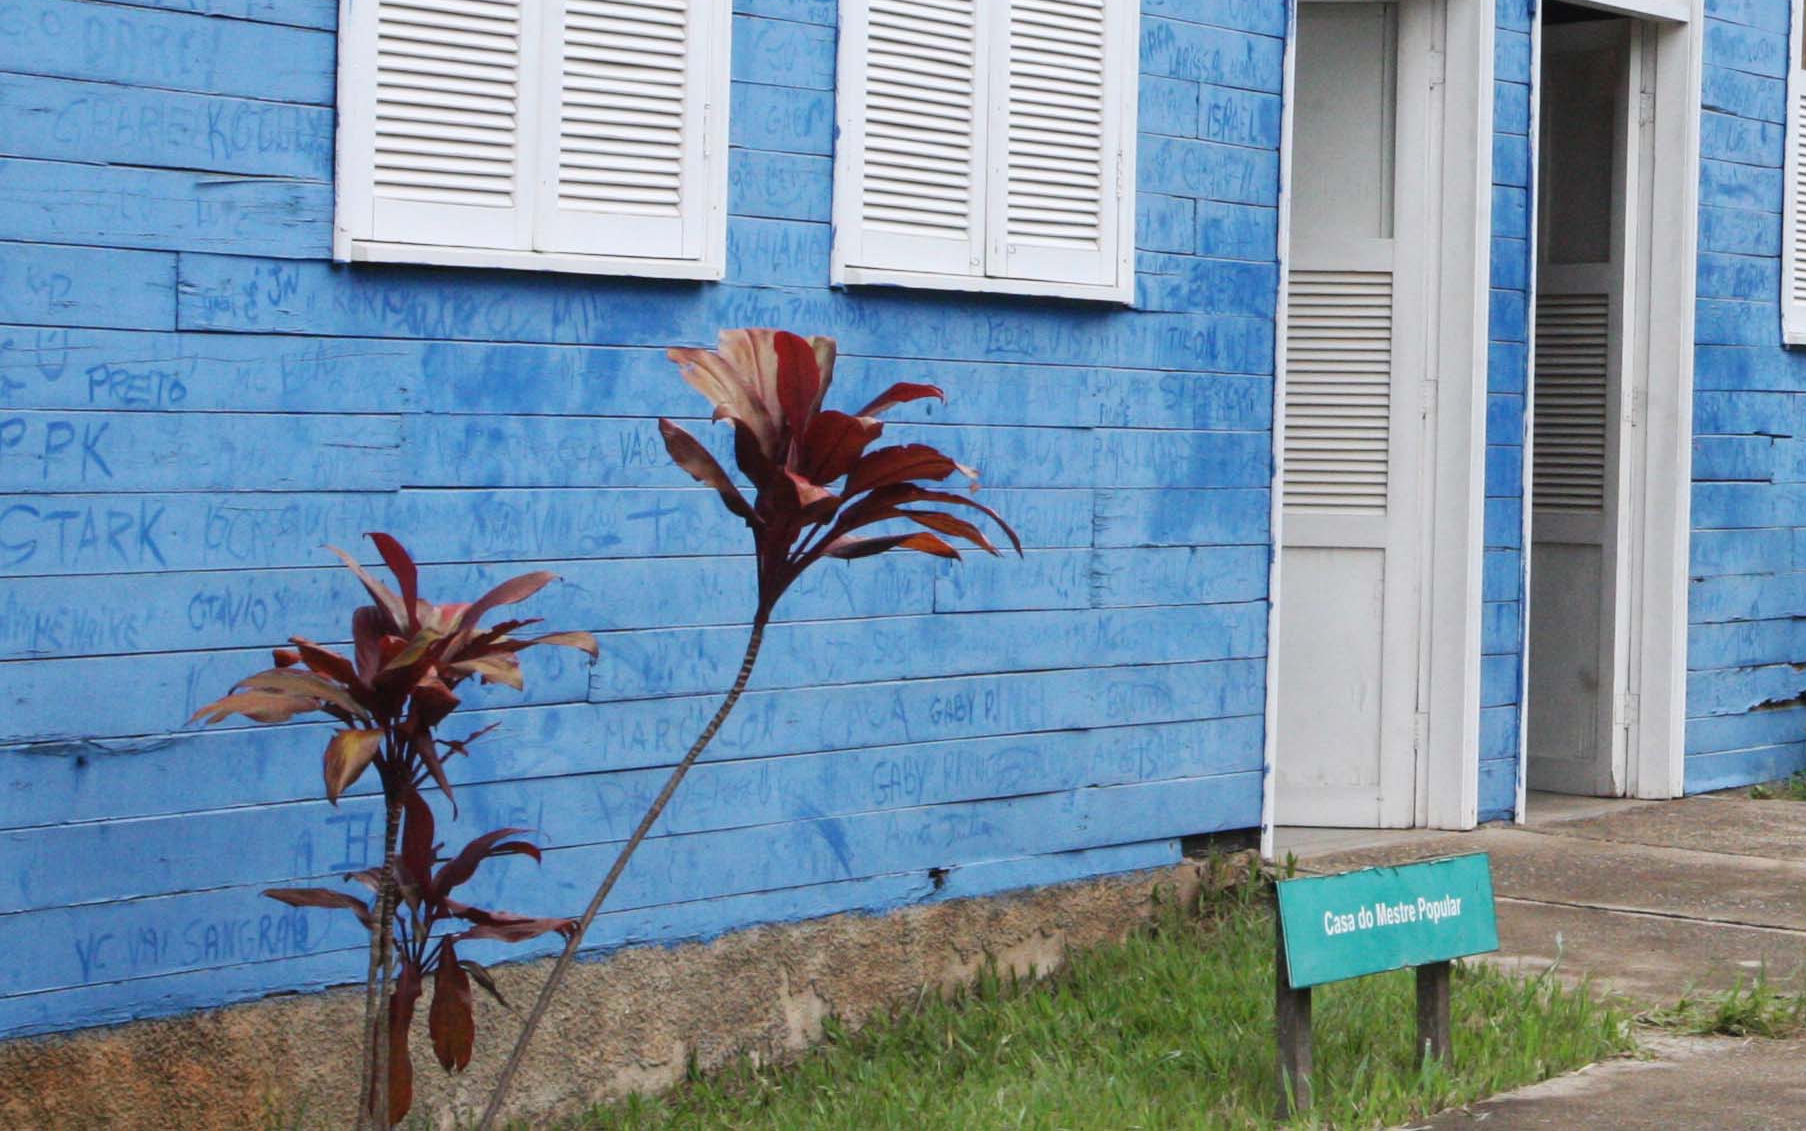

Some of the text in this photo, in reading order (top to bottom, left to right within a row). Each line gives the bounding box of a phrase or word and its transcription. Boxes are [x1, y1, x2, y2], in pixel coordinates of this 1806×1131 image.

[1324, 894, 1463, 936] Casa do Mestre Popular
